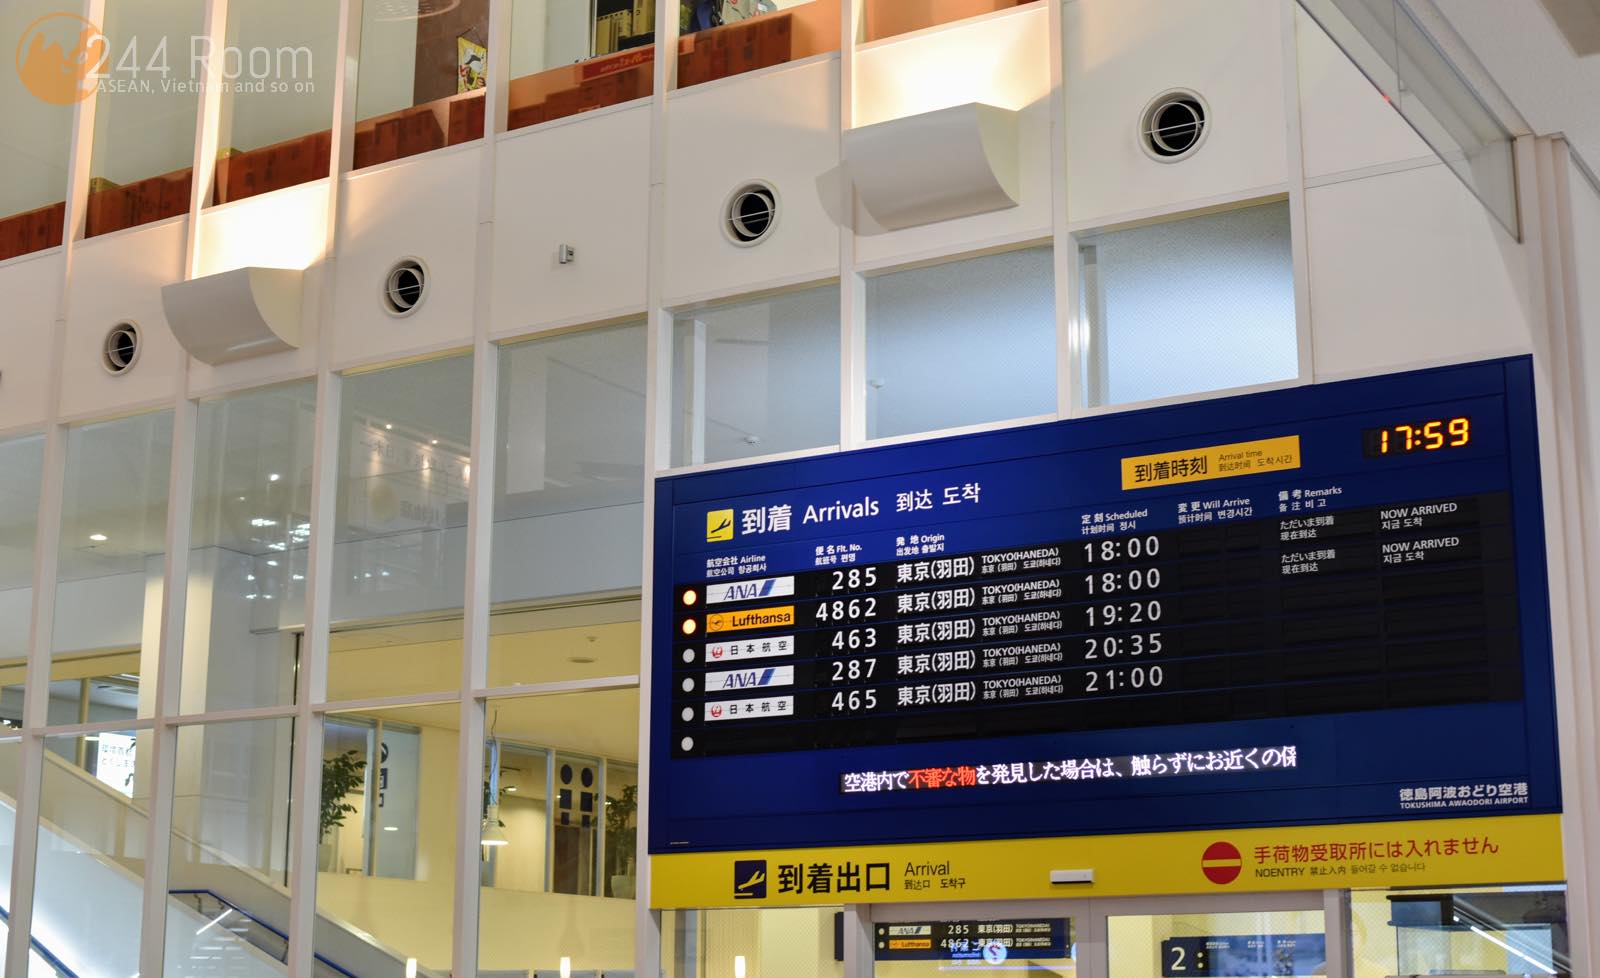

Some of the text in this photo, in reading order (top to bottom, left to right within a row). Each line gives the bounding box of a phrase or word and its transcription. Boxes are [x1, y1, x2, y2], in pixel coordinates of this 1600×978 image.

[1380, 417, 1469, 454] 17:59
[1218, 449, 1263, 462] Arrival time
[1257, 454, 1293, 468] 도착시간
[1135, 455, 1208, 483] 到着時刻
[1304, 485, 1343, 498] Remarks
[741, 482, 981, 536] 到着 Arrivals 到达 도착
[1202, 501, 1221, 511] Will
[1222, 497, 1250, 508] Arrive
[1380, 502, 1458, 520] NOW ARRIVED
[1105, 508, 1148, 521] Scheduled
[1217, 506, 1253, 520] 변경시간
[1081, 520, 1136, 536] 计划时间 정시
[1280, 515, 1335, 531] ただいま到着
[1381, 516, 1423, 531] 지금 도착
[920, 533, 945, 545] Origin
[1382, 536, 1460, 553] NOW ARRIVED
[836, 545, 848, 553] Flt.
[896, 542, 945, 556] 出发地 출발지
[982, 547, 1059, 564] TOKYO(HANEDA)
[1084, 535, 1160, 563] 18:00
[1281, 549, 1336, 563] ただいま到着
[1383, 550, 1424, 564] 지금 도착
[706, 554, 766, 569] 航空会社 Airline
[896, 556, 975, 583] 東京(羽田)
[831, 566, 877, 590] 285
[1084, 568, 1161, 595] 18:00
[723, 583, 758, 600] ANA
[982, 579, 1060, 595] TOKYO(HANEDA)
[896, 587, 976, 614] 東京(羽田)
[815, 597, 877, 622] 4862
[1085, 601, 1161, 627] 19:20
[732, 612, 791, 628] Lufthansa
[982, 610, 1061, 627] TOKYO(HANEDA)
[831, 627, 877, 650] 463
[897, 618, 976, 645] 東京(羽田)
[730, 640, 787, 656] 日本航空
[983, 642, 1061, 658] TOKYO(HANEDA)
[1085, 633, 1162, 660] 20:35
[831, 658, 877, 681] 287
[897, 649, 977, 675] 東京(羽田)
[722, 671, 757, 689] ANA
[983, 674, 1062, 690] TOKYO(HANEDA)
[1085, 666, 1163, 693] 21:00
[831, 689, 877, 711] 465
[897, 680, 977, 706] 東京(羽田)
[729, 700, 787, 715] 日本航空
[1399, 782, 1528, 802] 徳島阿波おどり空港
[1399, 796, 1528, 809] TOKUSHIMA AWAODORI AIRPORT
[1254, 836, 1499, 865] 手荷物受取所には入れません
[904, 861, 950, 877] Arrival
[1255, 867, 1305, 878] NOENTRY
[1310, 866, 1346, 876] 禁止入内
[1379, 863, 1388, 873] 수
[1391, 863, 1425, 874] 없습니다
[778, 861, 891, 894] 到着出口
[904, 878, 966, 890] 到达口 도착구
[947, 925, 969, 935] 285
[940, 938, 969, 948] 4862
